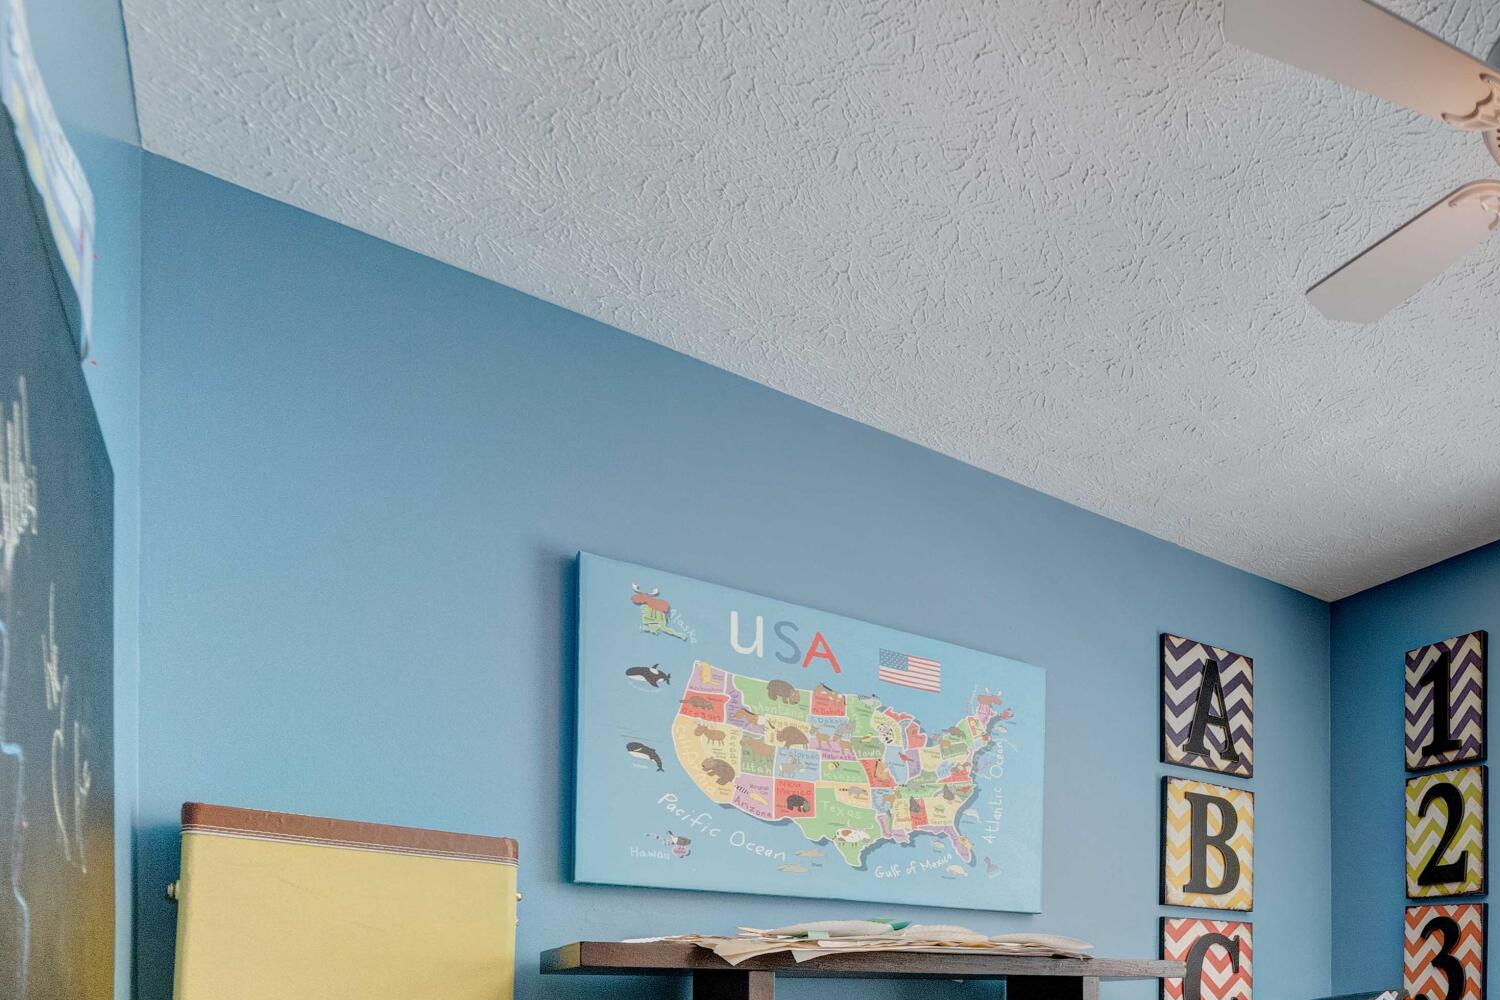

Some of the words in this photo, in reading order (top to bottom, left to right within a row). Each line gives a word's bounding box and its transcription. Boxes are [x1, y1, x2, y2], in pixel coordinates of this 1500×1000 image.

[730, 611, 841, 673] USA
[1183, 658, 1240, 763] A
[1419, 650, 1462, 756] 1
[658, 793, 721, 837] Pacific
[729, 831, 786, 862] Ocean
[823, 801, 861, 819] Texas
[1183, 791, 1240, 895] B
[1417, 782, 1469, 886] 2
[875, 864, 901, 878] Gulf
[906, 861, 918, 874] of
[920, 854, 952, 871] Mexico
